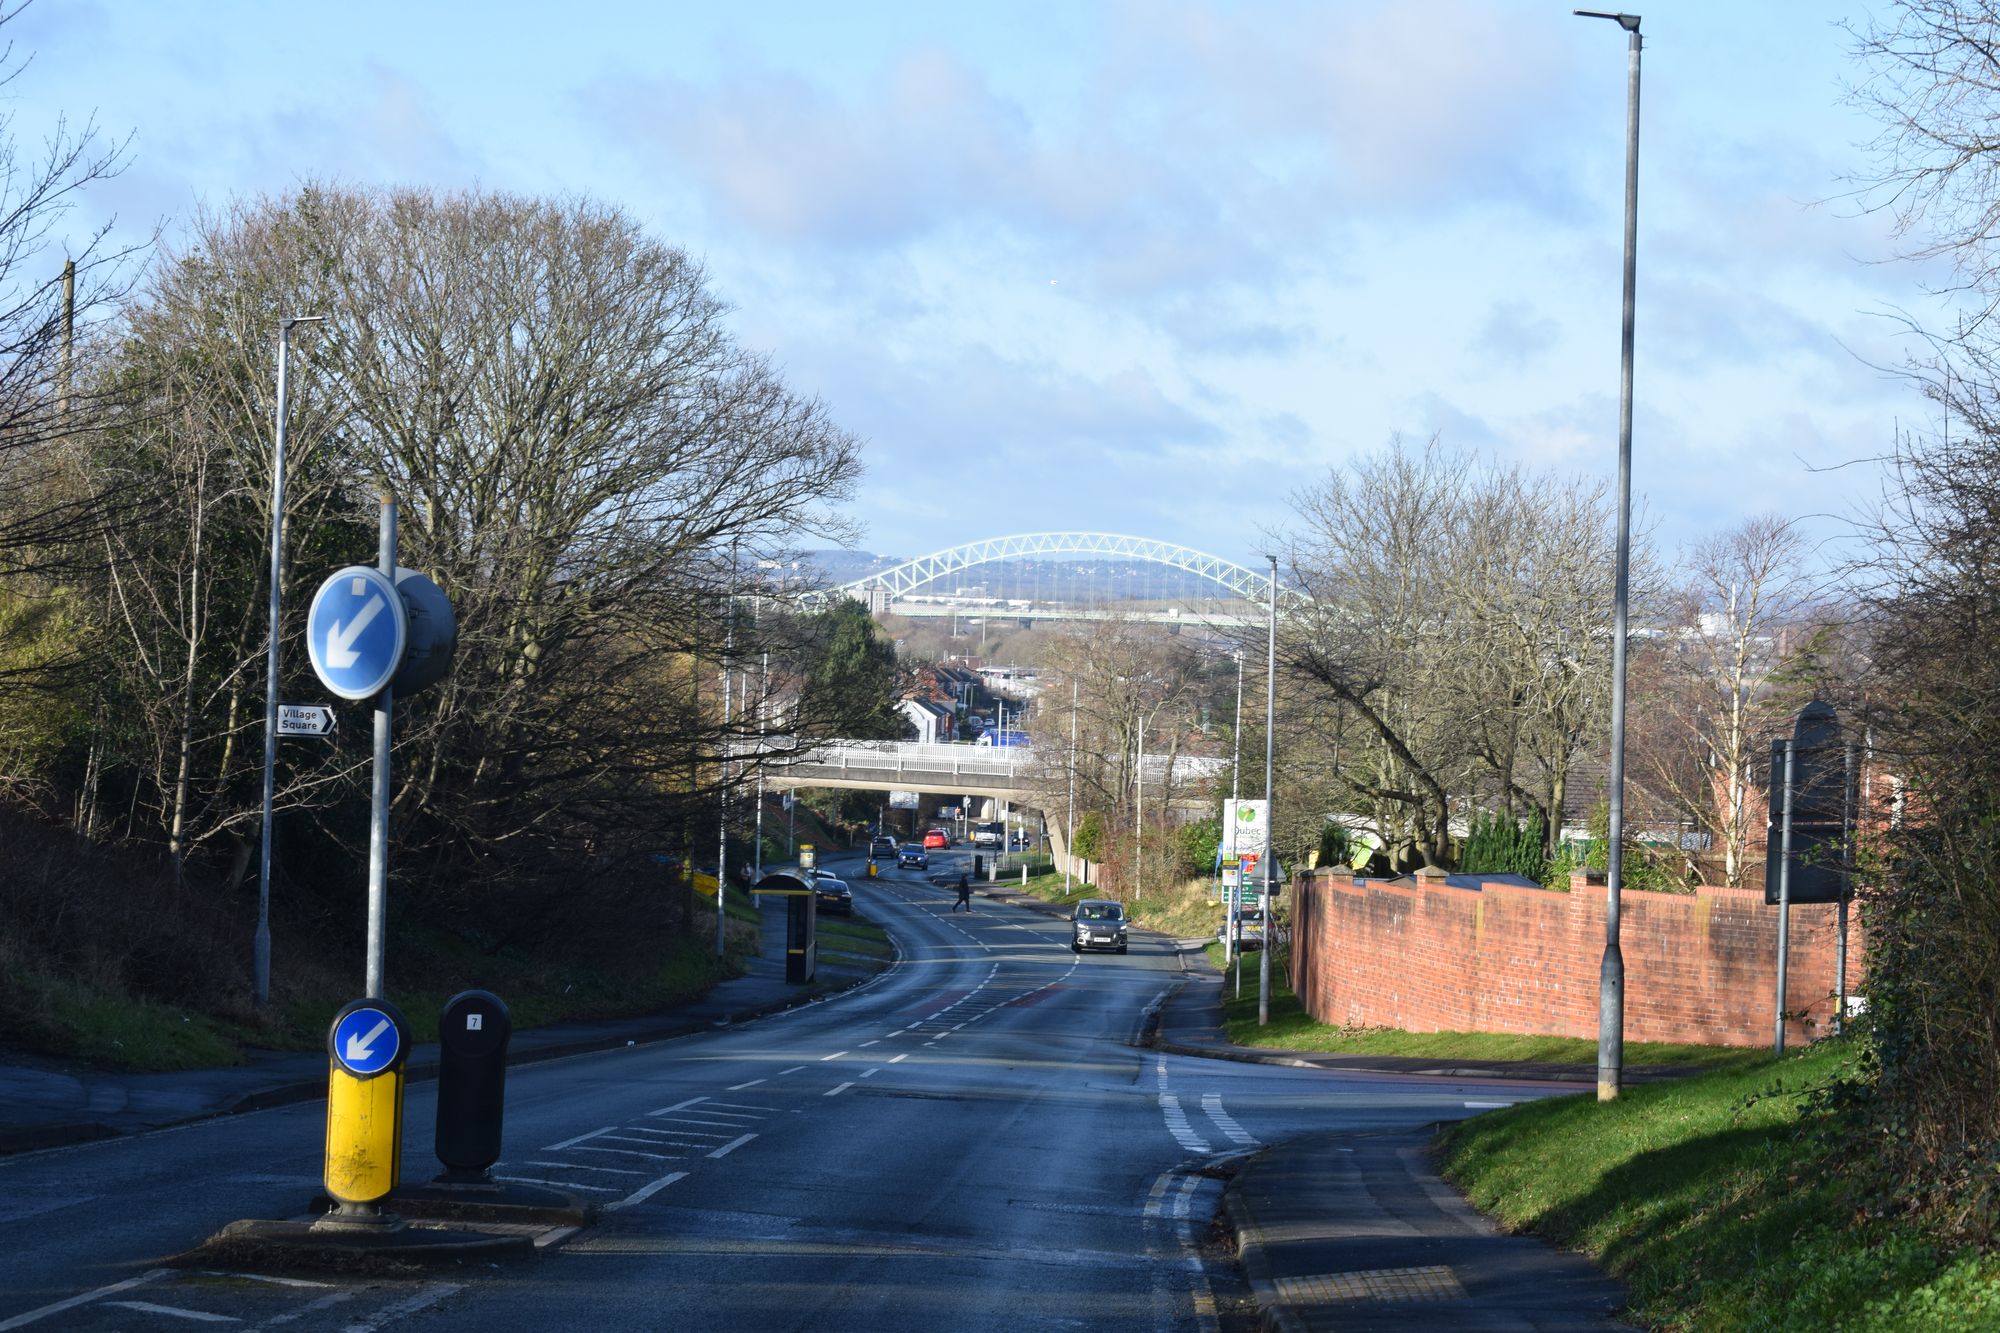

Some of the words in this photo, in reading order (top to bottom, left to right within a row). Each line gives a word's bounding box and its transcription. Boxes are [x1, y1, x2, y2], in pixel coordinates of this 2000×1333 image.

[283, 709, 317, 720] Village
[282, 720, 317, 730] Square
[472, 1017, 478, 1028] 7
